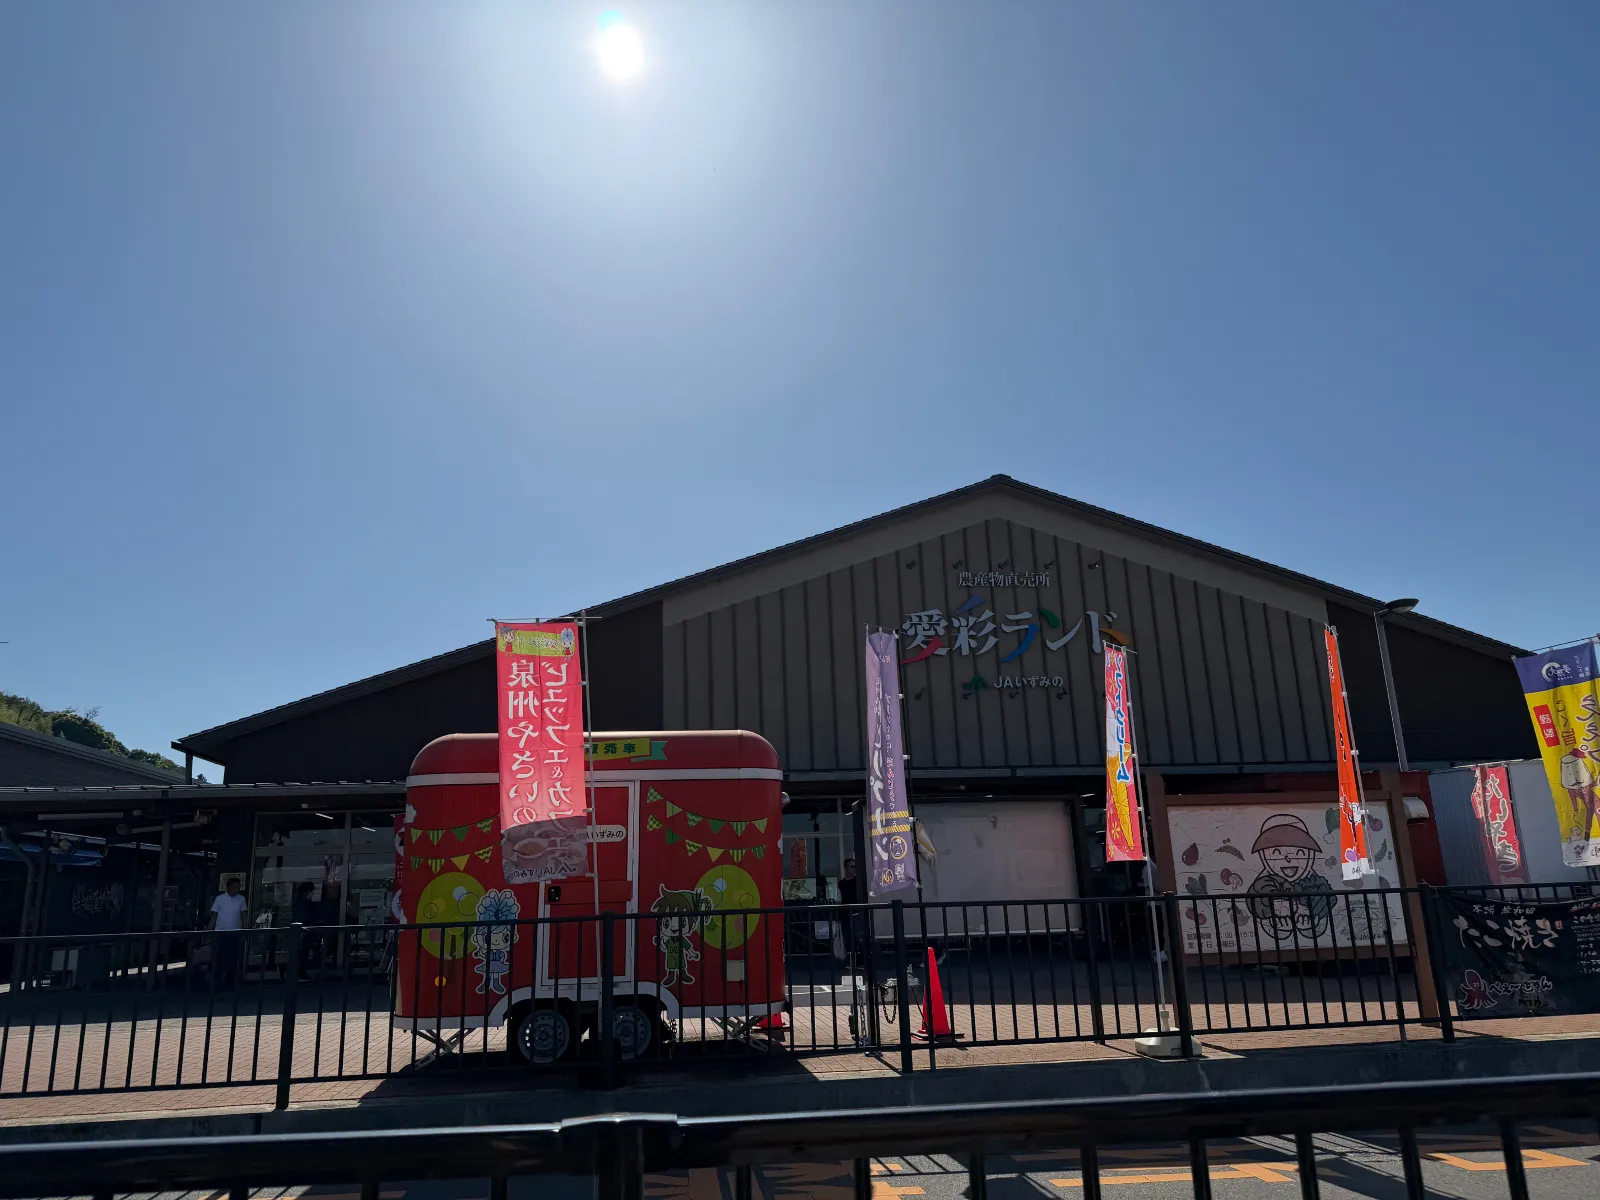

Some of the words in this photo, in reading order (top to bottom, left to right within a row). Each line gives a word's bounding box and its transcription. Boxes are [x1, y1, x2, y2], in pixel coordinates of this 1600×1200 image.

[958, 571, 1051, 588] 農産物直売所
[901, 594, 1130, 664] 愛彩ランド
[993, 675, 1064, 688] JAいずみの
[1453, 915, 1559, 950] たこ焼き
